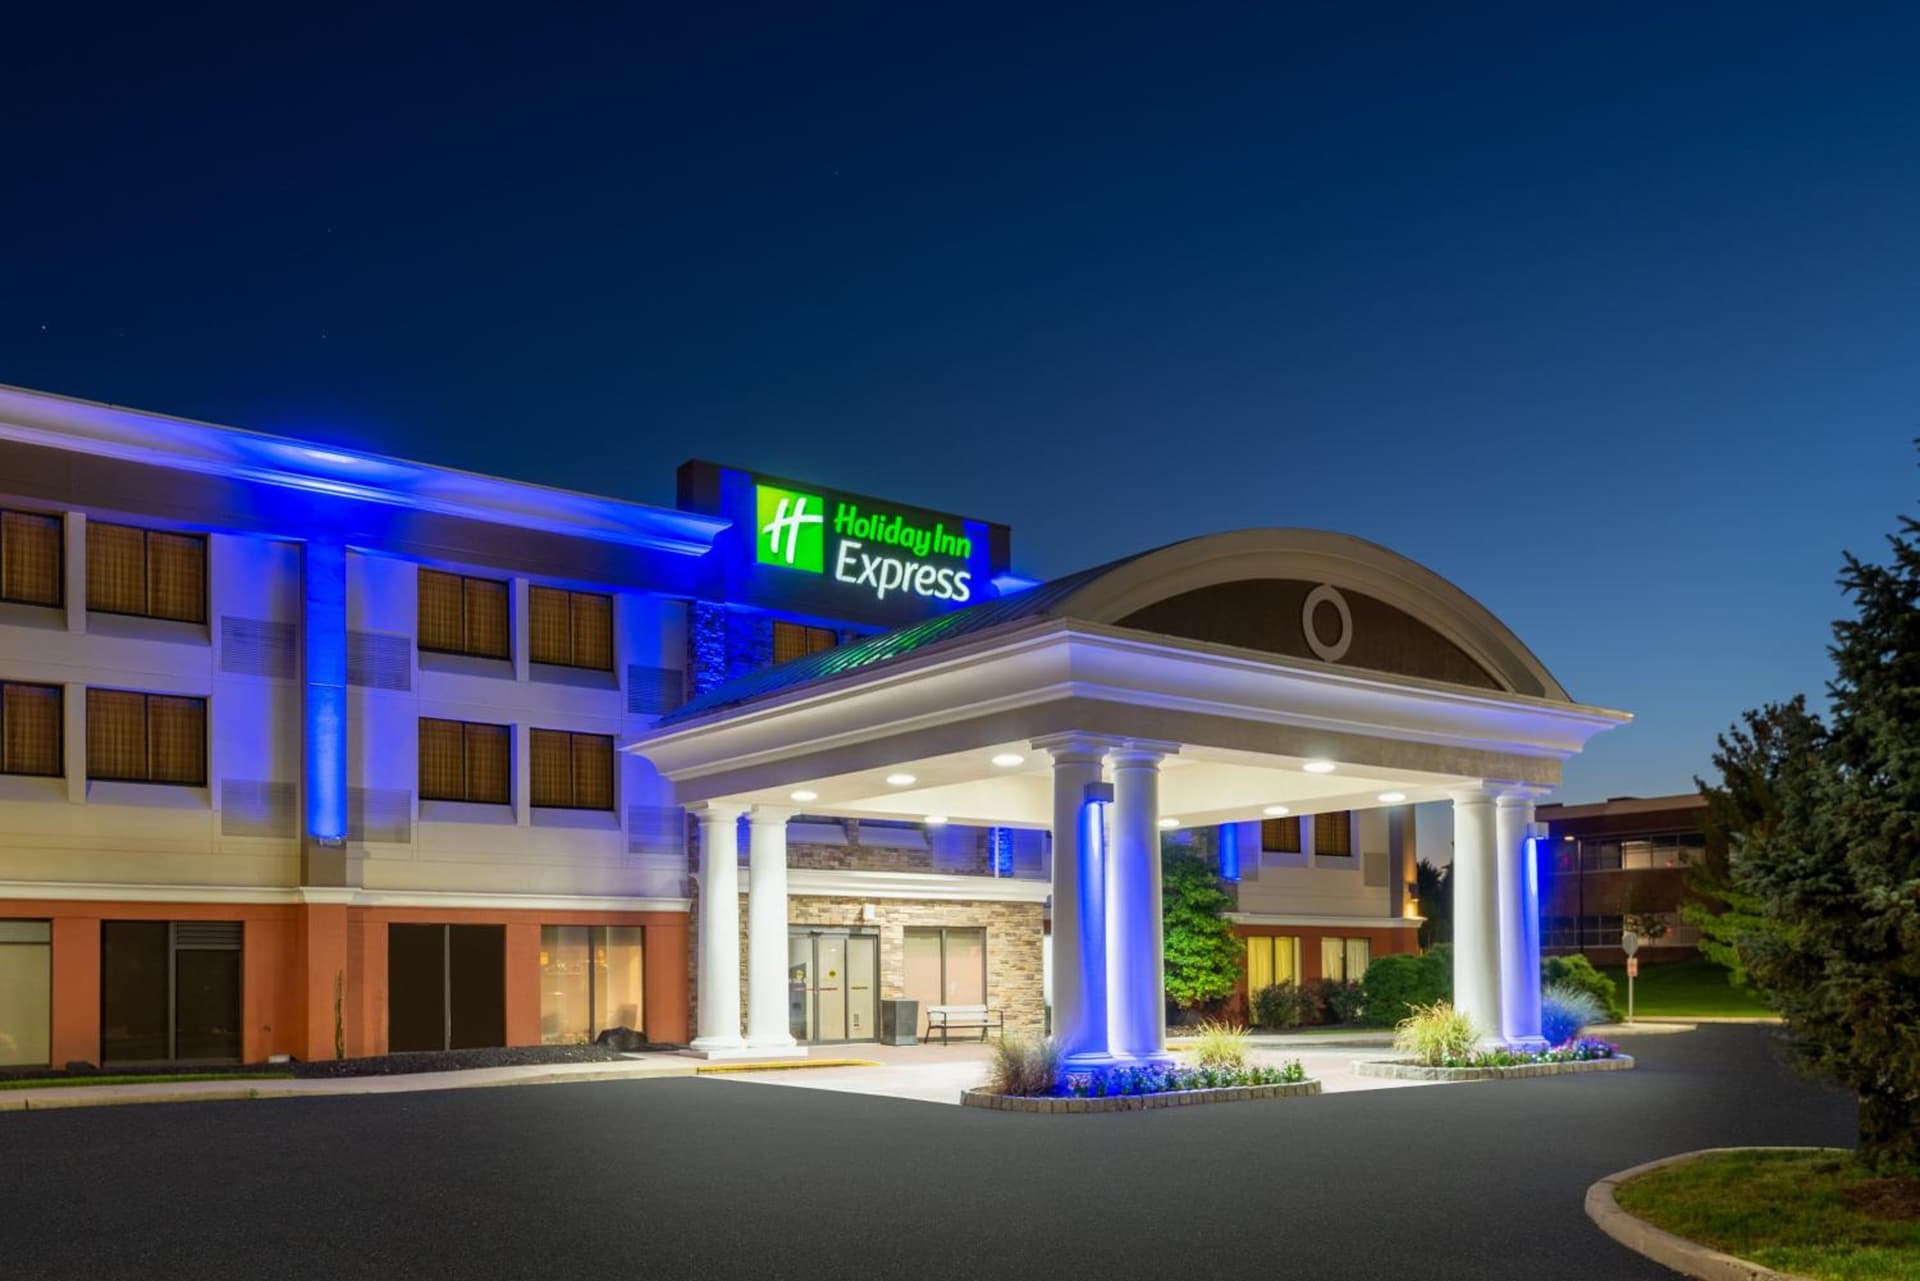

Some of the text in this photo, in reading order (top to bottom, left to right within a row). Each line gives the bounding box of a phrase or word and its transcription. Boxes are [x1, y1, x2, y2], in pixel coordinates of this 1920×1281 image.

[834, 503, 972, 559] Holiday Inn
[835, 540, 972, 602] Express
